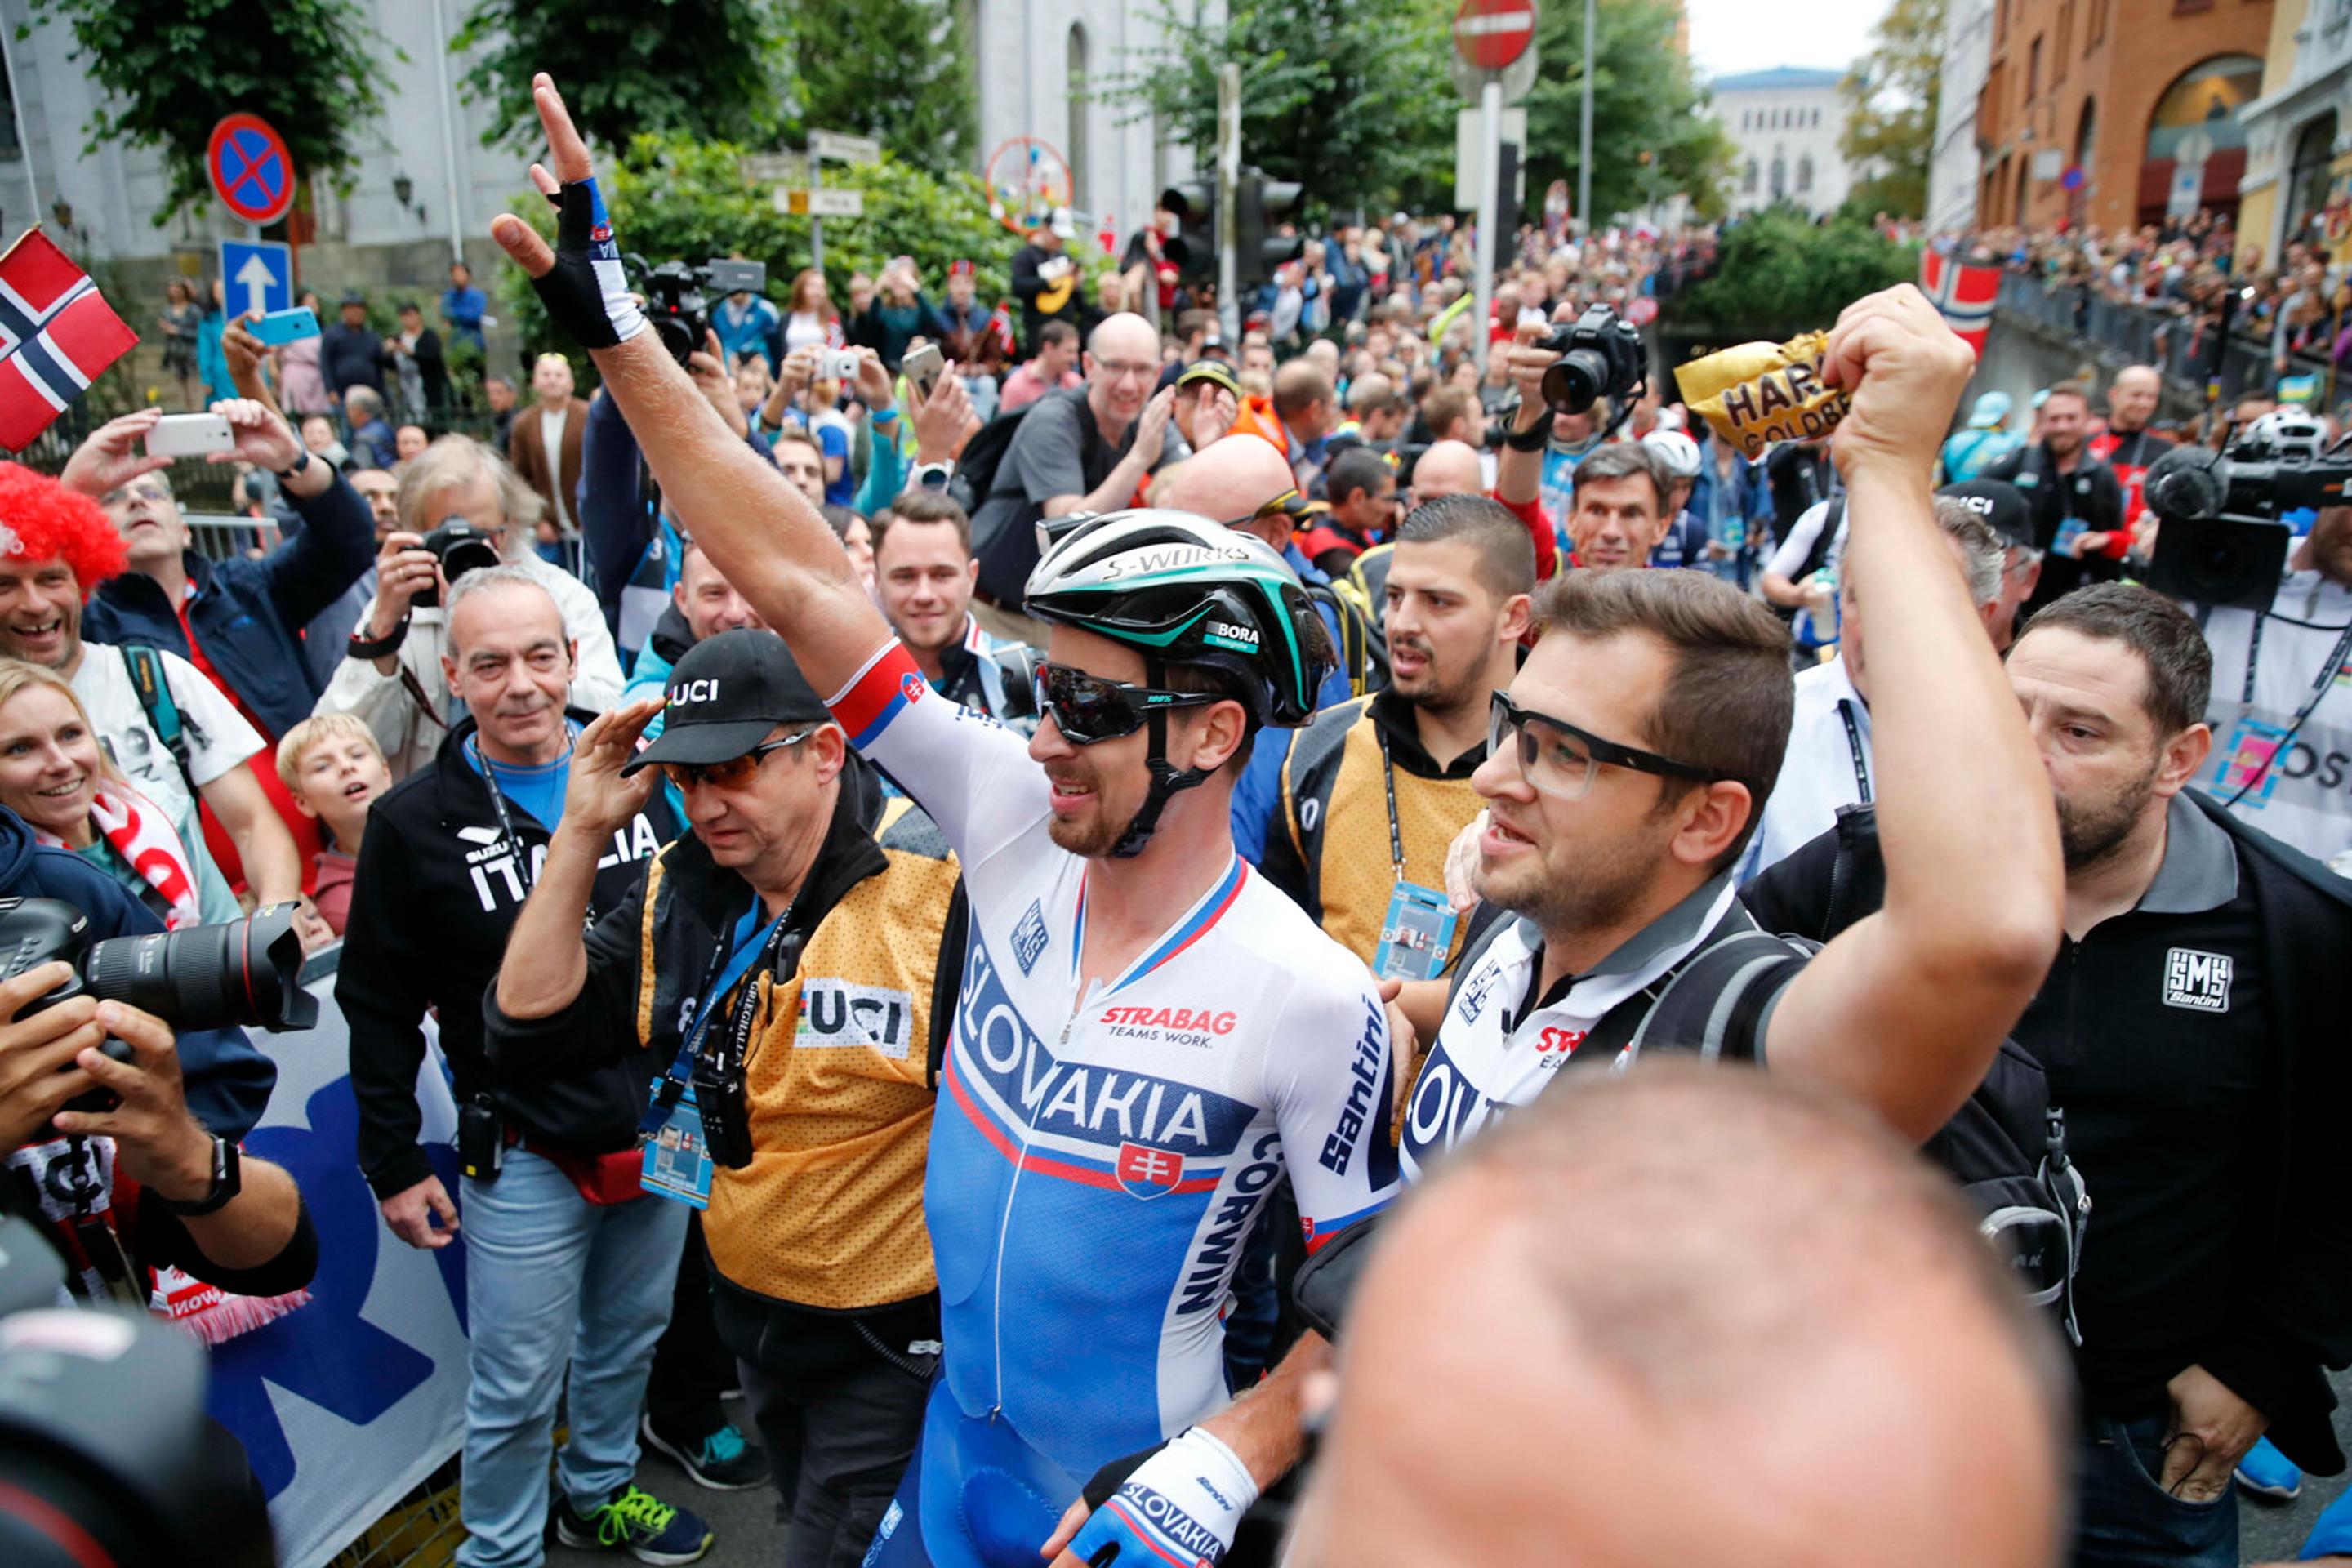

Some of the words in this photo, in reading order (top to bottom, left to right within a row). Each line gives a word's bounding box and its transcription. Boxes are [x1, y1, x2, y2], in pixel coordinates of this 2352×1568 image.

[1102, 546, 1250, 581] S-WORKS
[1218, 622, 1259, 644] BORA
[672, 679, 719, 707] UCI
[2169, 951, 2229, 996] SMS
[811, 989, 902, 1045] UCI
[1099, 1006, 1237, 1036] STRABAG
[1109, 1025, 1158, 1041] TEAMS
[1165, 1031, 1214, 1049] WORK.
[963, 943, 1209, 1147] SLOVAKIA
[1318, 993, 1383, 1177] Santini
[1176, 1132, 1285, 1316] CORWIN
[1122, 1482, 1222, 1562] SLOVAKIA
